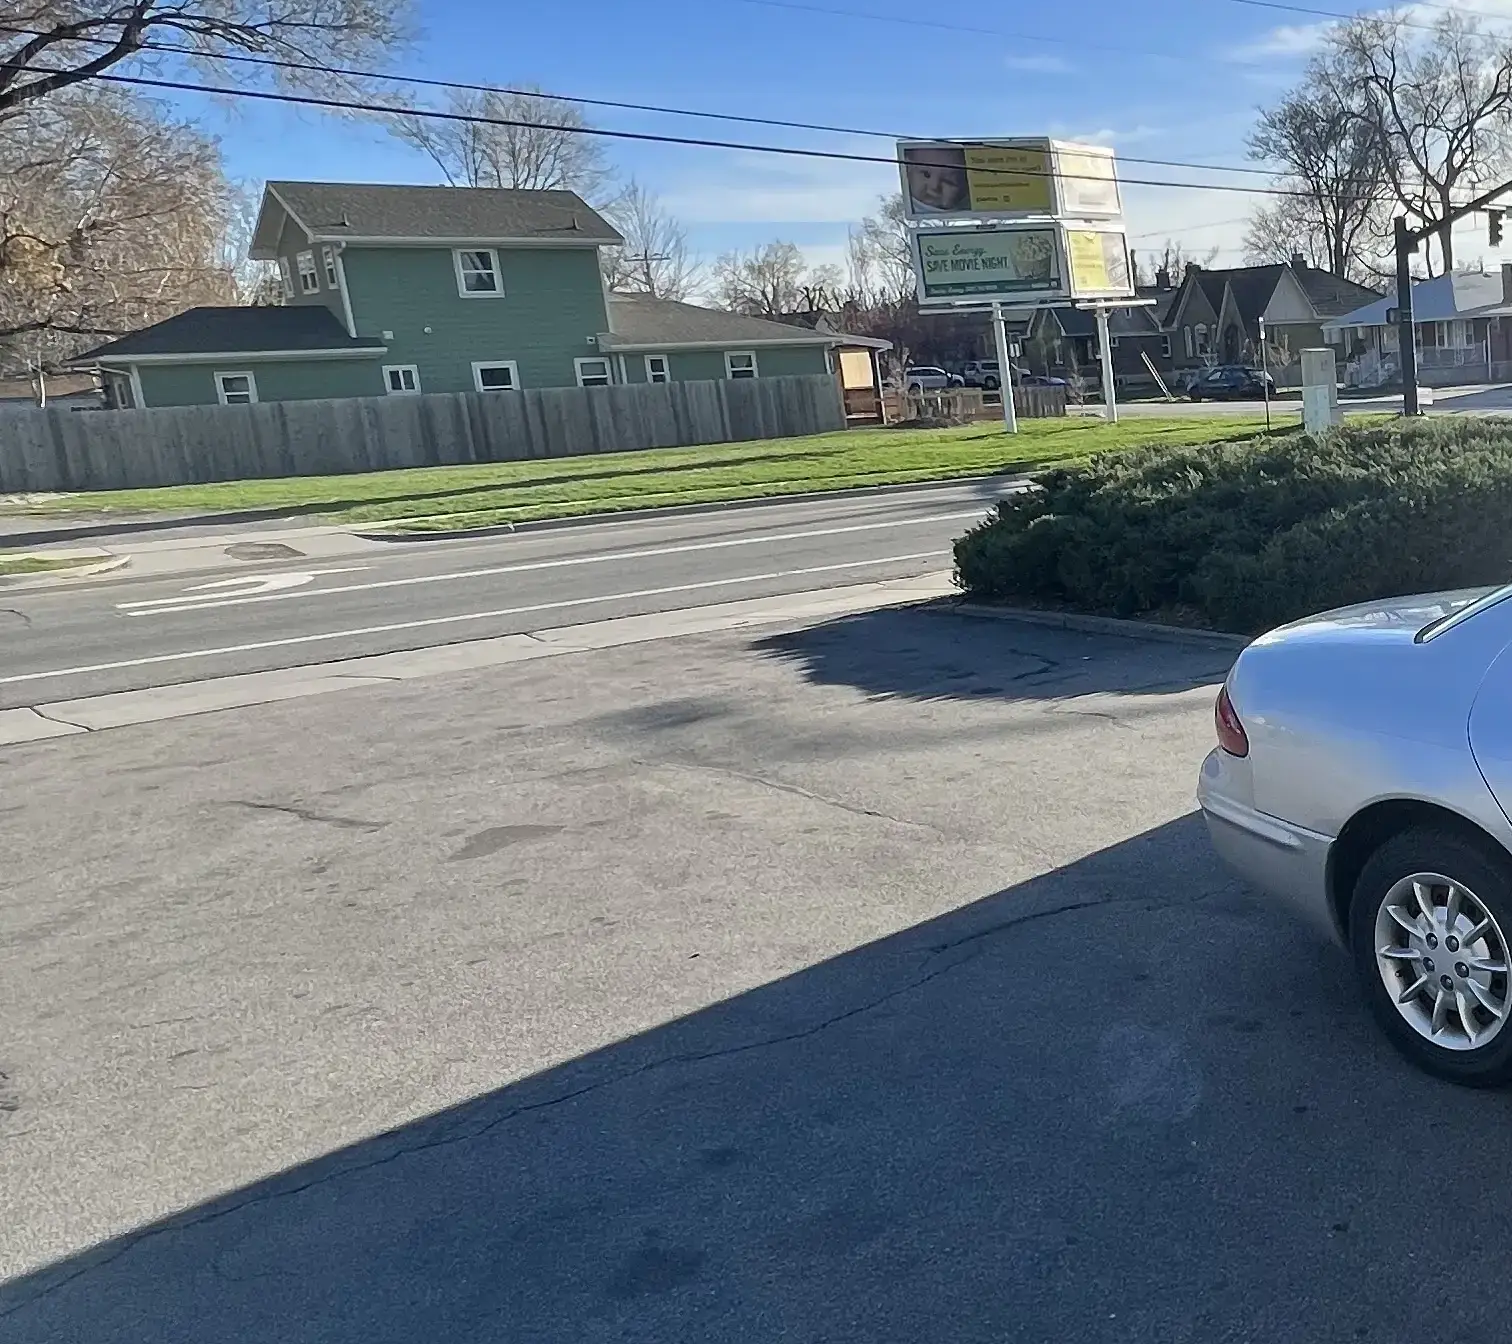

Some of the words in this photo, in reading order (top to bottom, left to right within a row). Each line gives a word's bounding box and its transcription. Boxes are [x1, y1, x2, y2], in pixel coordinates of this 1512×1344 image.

[926, 259, 949, 272] SAVE
[951, 258, 980, 271] MOVIE
[981, 256, 1008, 270] NIGHT
